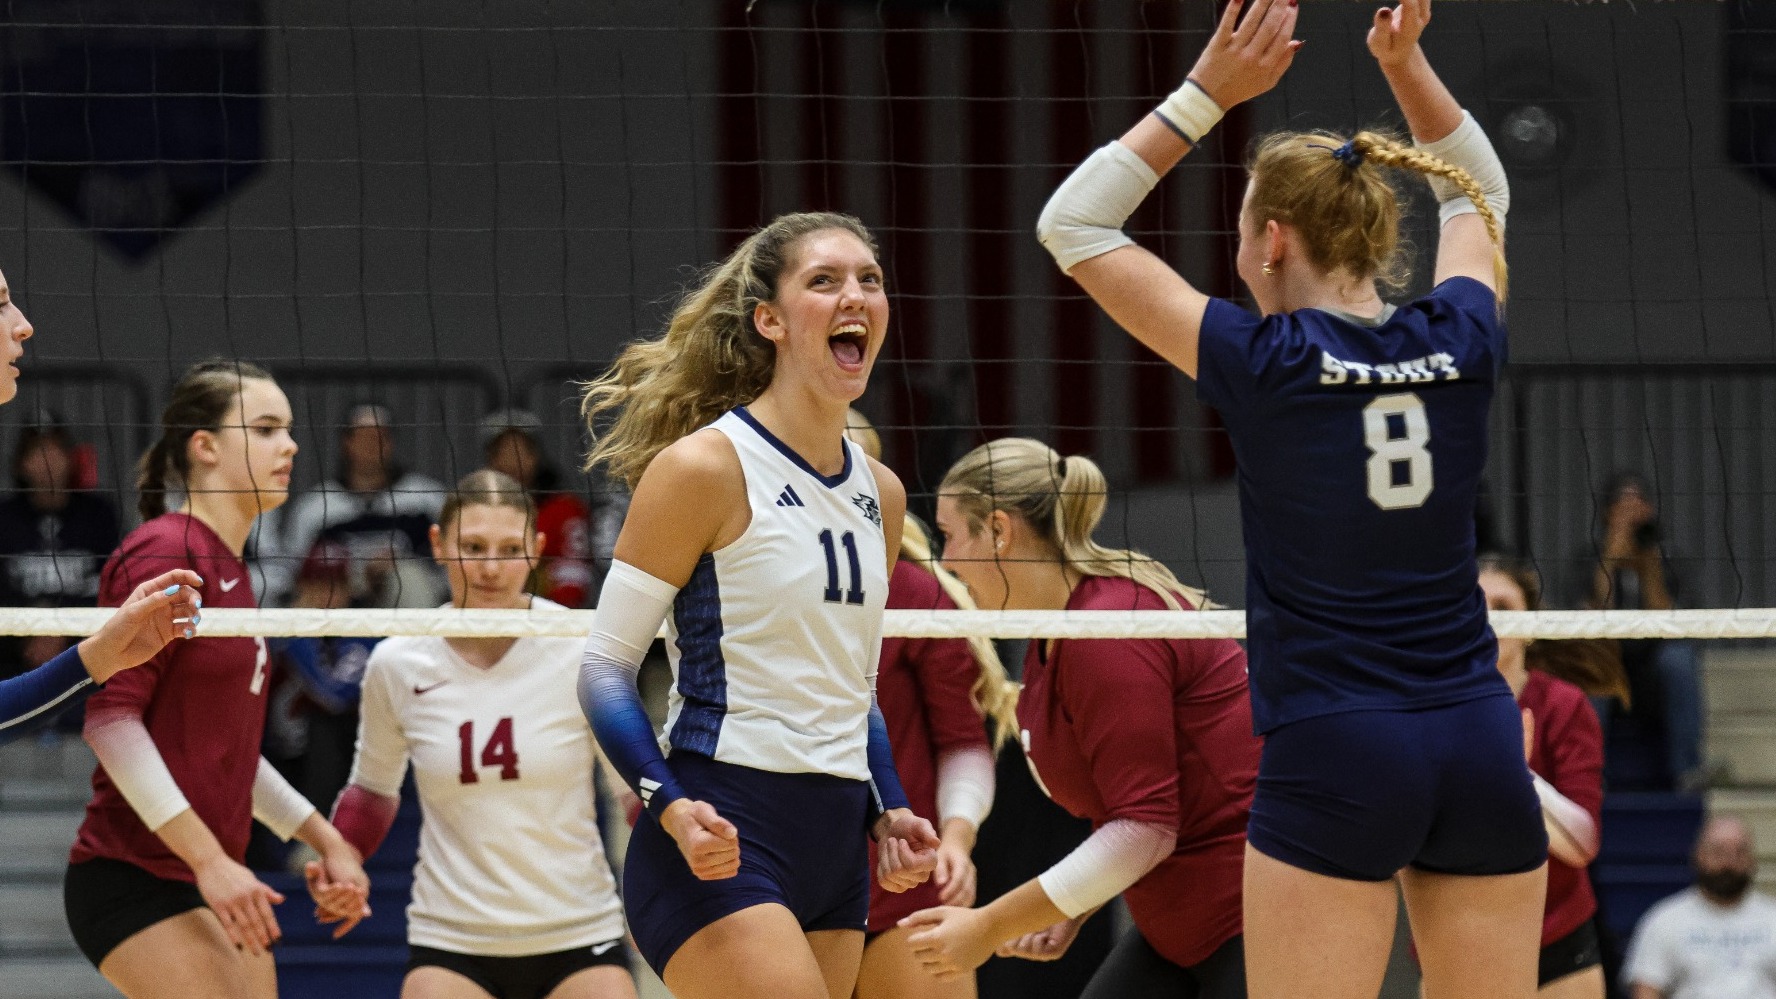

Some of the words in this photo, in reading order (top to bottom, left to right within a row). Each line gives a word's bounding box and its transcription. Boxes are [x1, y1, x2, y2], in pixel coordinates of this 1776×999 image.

[1361, 391, 1435, 511] 8
[818, 527, 866, 606] 11
[458, 716, 520, 784] 14
